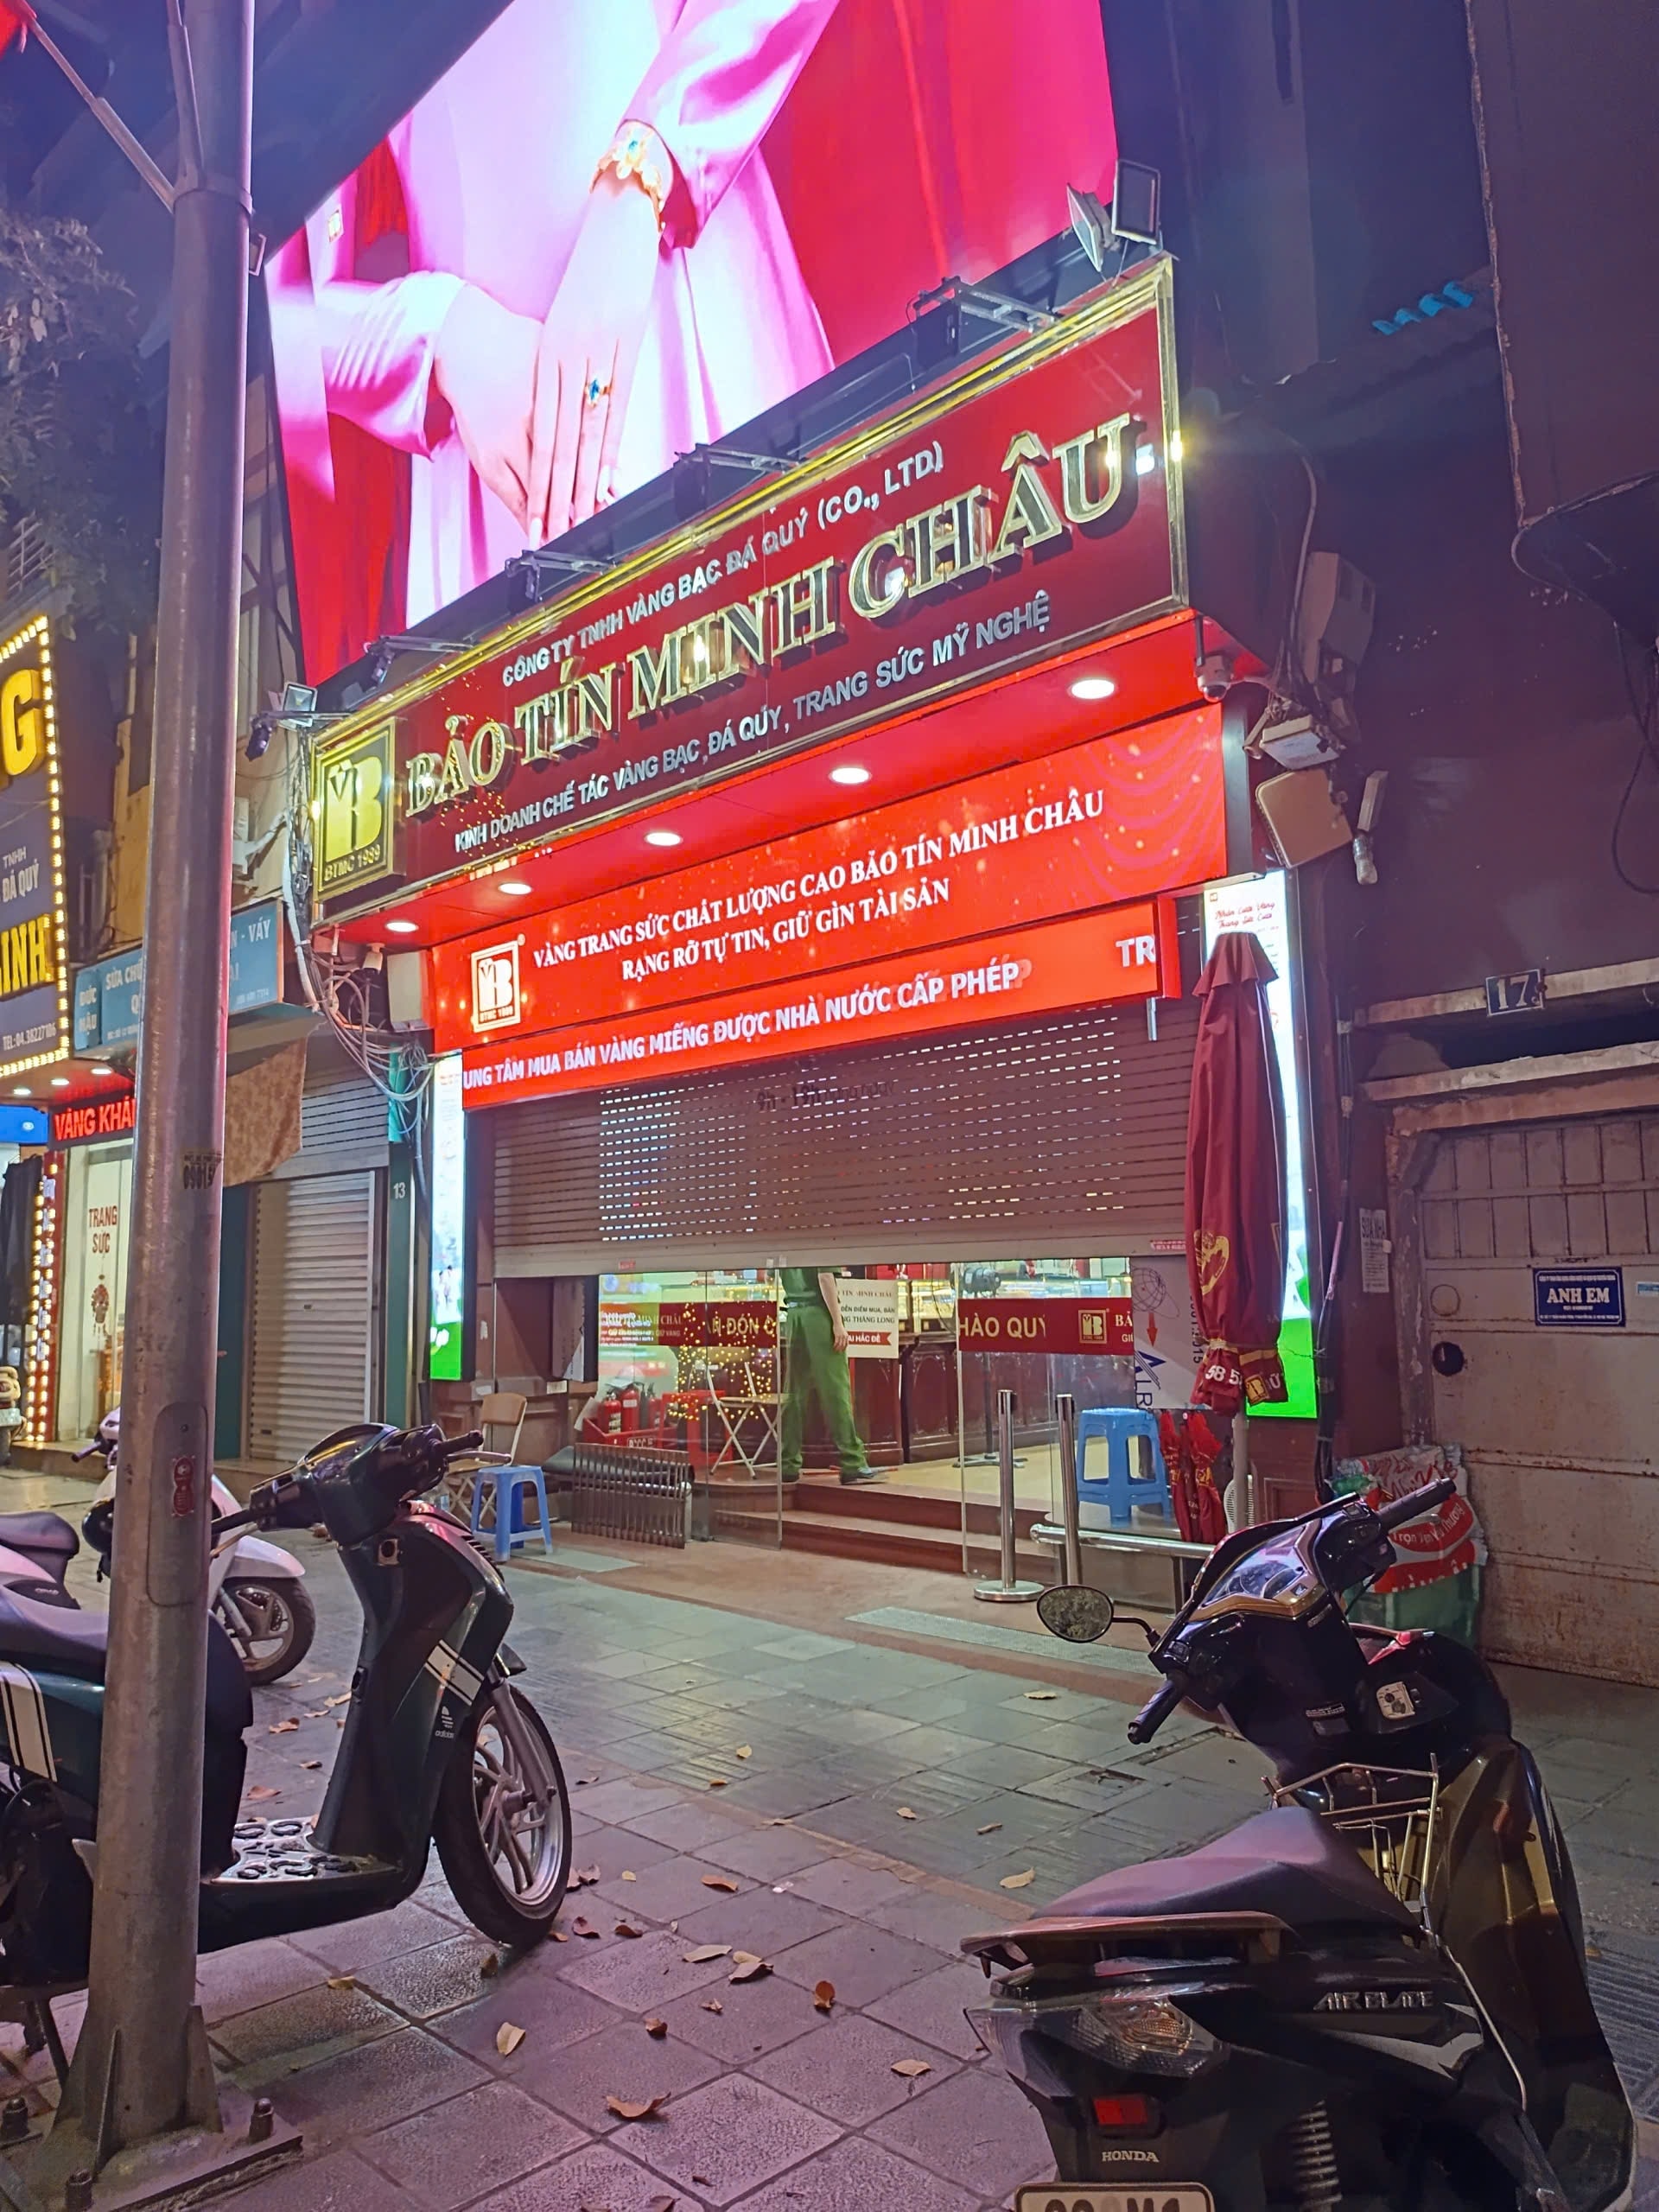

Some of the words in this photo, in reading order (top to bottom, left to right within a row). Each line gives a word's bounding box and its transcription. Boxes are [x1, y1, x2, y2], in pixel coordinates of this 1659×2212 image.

[502, 647, 550, 687] CÔNG
[551, 635, 575, 662] TY
[577, 609, 623, 649] TNHH
[626, 582, 675, 625] VÀNG
[678, 559, 723, 600] BẠC
[884, 441, 944, 495] LTD)
[405, 715, 506, 818] BẢO
[514, 657, 617, 766] TÍN
[626, 556, 836, 720] MINH
[849, 412, 1132, 620] CHÂU
[455, 823, 487, 852] KINH
[490, 802, 540, 839] DOANH
[542, 779, 575, 818] CHẾ
[578, 773, 609, 804] TÁC
[613, 755, 658, 791] VÀNG
[793, 671, 868, 720] TRANG
[875, 645, 925, 688] SỨC
[932, 622, 969, 666] MỸ
[976, 588, 1050, 649] NGHỆ
[324, 855, 355, 881] BTMC
[358, 844, 381, 868] 1989
[533, 941, 575, 968] VÀNG
[577, 925, 632, 957] TRANG
[635, 912, 670, 941] SỨC
[727, 880, 796, 918] LƯỢNG
[800, 866, 846, 897] CAO
[850, 850, 898, 885] BẢO
[901, 833, 943, 870] TÍN
[949, 815, 1019, 857] MINH
[1024, 788, 1103, 834] CHÂU
[621, 950, 670, 982] RẠNG
[672, 940, 699, 969] RỠ
[702, 931, 730, 963] TỰ
[731, 926, 770, 953] TIN,
[772, 910, 813, 943] GIỮ
[816, 900, 855, 932] GÌN
[859, 888, 898, 921] TÀI
[903, 876, 950, 912] SẢN
[0, 914, 48, 995] INH
[1495, 974, 1532, 1009] 17
[495, 1057, 524, 1081] TÂM
[528, 1053, 561, 1077] MUA
[564, 1042, 596, 1071] BÁN
[599, 1036, 645, 1065] VÀNG
[713, 1012, 771, 1044] ĐƯỢC
[775, 995, 820, 1032] NHÀ
[825, 983, 891, 1023] NƯỚC
[951, 957, 1020, 999] PHÉP
[54, 1108, 96, 1141] VÀNG
[393, 1182, 406, 1199] 13
[89, 1205, 118, 1228] TRANG
[92, 1229, 111, 1253] SỨC
[1547, 1287, 1582, 1303] ANH
[1586, 1287, 1610, 1303] EM
[726, 1313, 760, 1335] ĐÓN
[1313, 1992, 1363, 2010] AIR
[1102, 2150, 1160, 2163] HONDA
